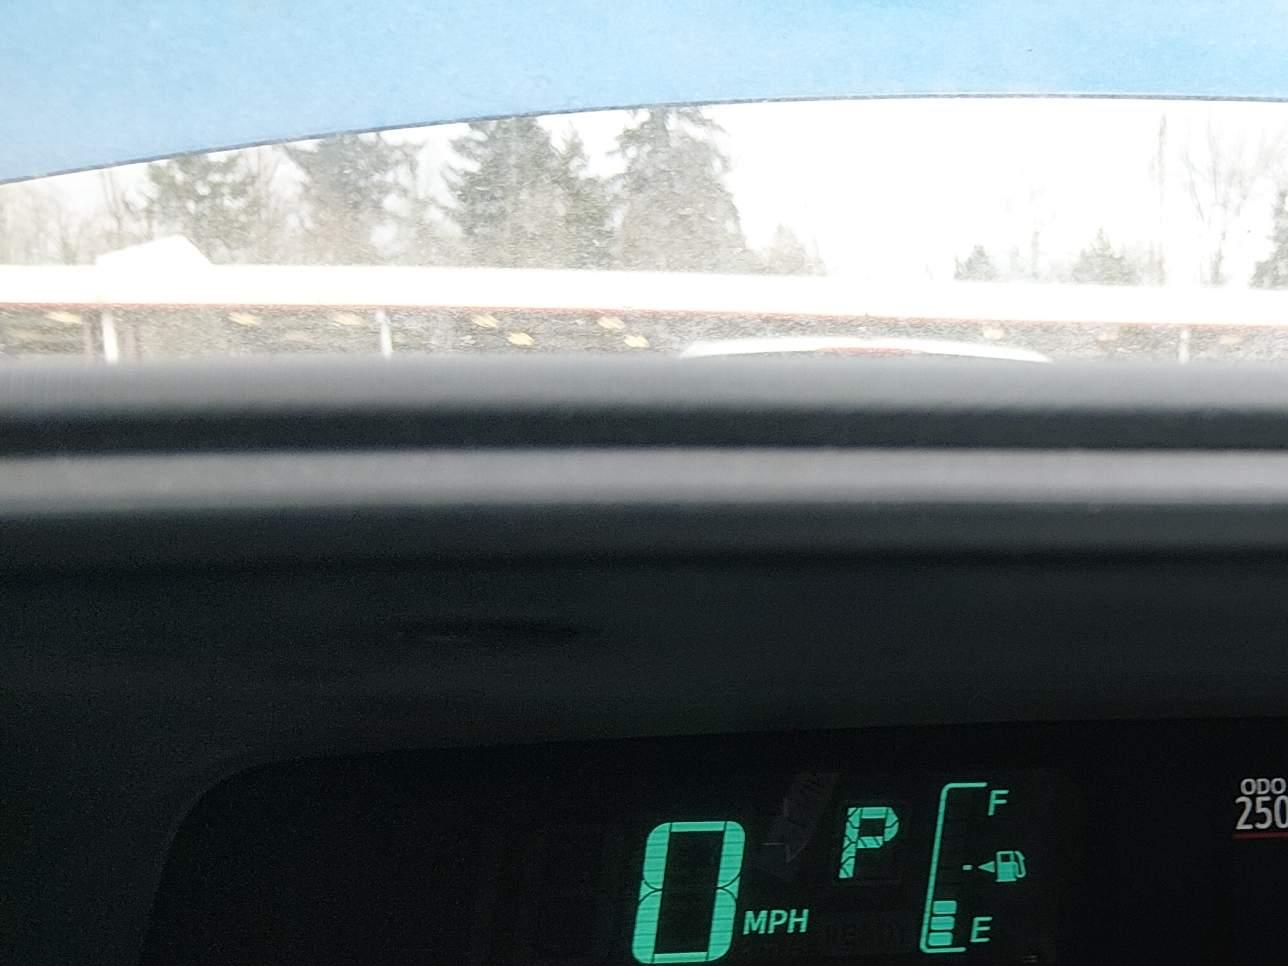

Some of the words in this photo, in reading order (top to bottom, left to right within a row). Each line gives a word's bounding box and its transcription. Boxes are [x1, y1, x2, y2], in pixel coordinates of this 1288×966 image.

[1240, 777, 1287, 795] ODO
[987, 788, 1010, 816] F
[838, 806, 900, 879] P
[631, 820, 747, 965] 0
[743, 908, 810, 936] MPH
[969, 916, 993, 944] E
